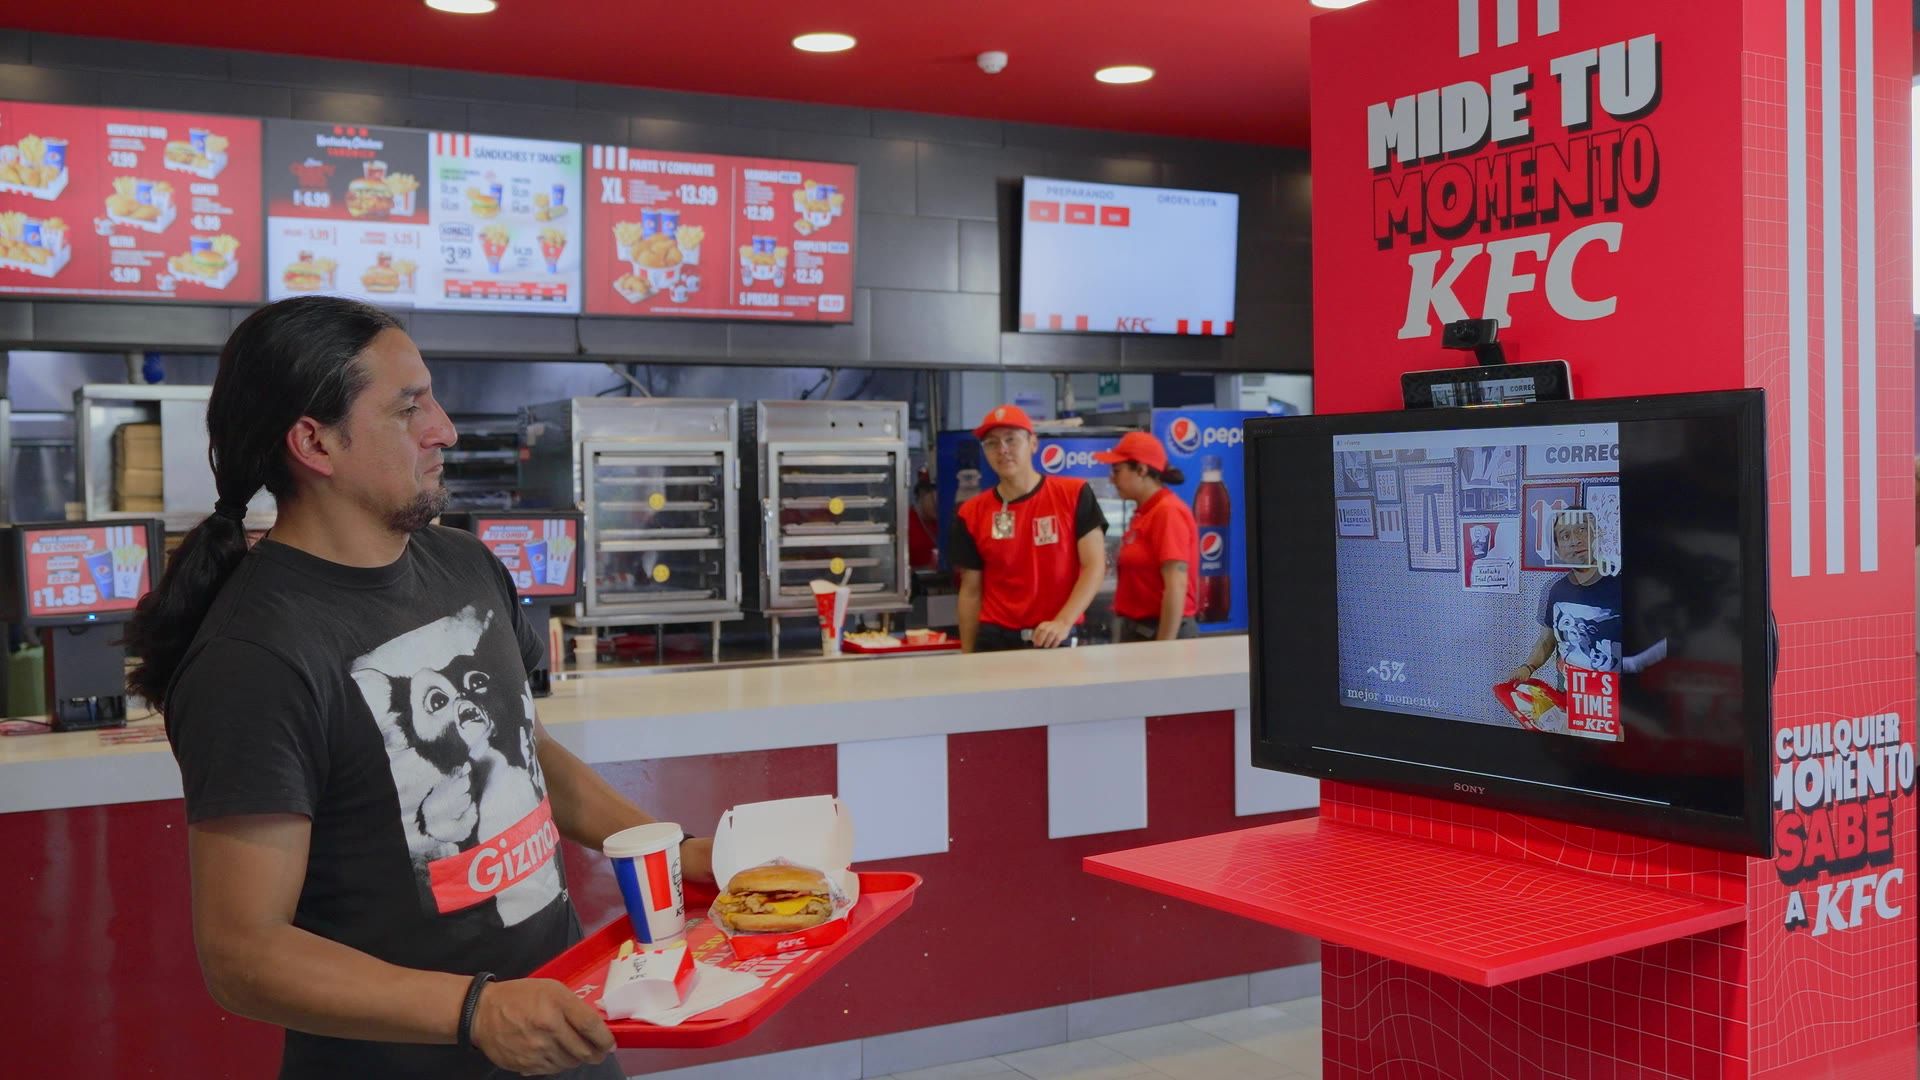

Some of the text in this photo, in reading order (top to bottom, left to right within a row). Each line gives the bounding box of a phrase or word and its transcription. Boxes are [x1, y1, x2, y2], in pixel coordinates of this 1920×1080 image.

[1367, 33, 1660, 172] MIDE TU
[538, 153, 572, 165] SNACKS
[660, 160, 667, 173] Y
[601, 176, 625, 204] XL
[1046, 186, 1114, 201] PREPARANDO
[1373, 124, 1659, 248] MOMENTO
[1158, 194, 1218, 207] ORDEN LISTA
[1397, 222, 1623, 339] KFC
[1116, 317, 1153, 332] KFC
[1203, 427, 1244, 448] pep
[1348, 689, 1379, 702] mejor
[1385, 694, 1439, 707] momento
[1572, 694, 1612, 718] TIME
[1584, 718, 1614, 732] KFC
[1776, 712, 1900, 760] CUALQUIER
[1773, 743, 1915, 812] MOMENTO
[1453, 782, 1486, 796] SONY
[1776, 797, 1893, 880] SABE
[468, 820, 554, 892] Gizmo
[1784, 868, 1903, 936] A KFC
[776, 937, 806, 950] KFC
